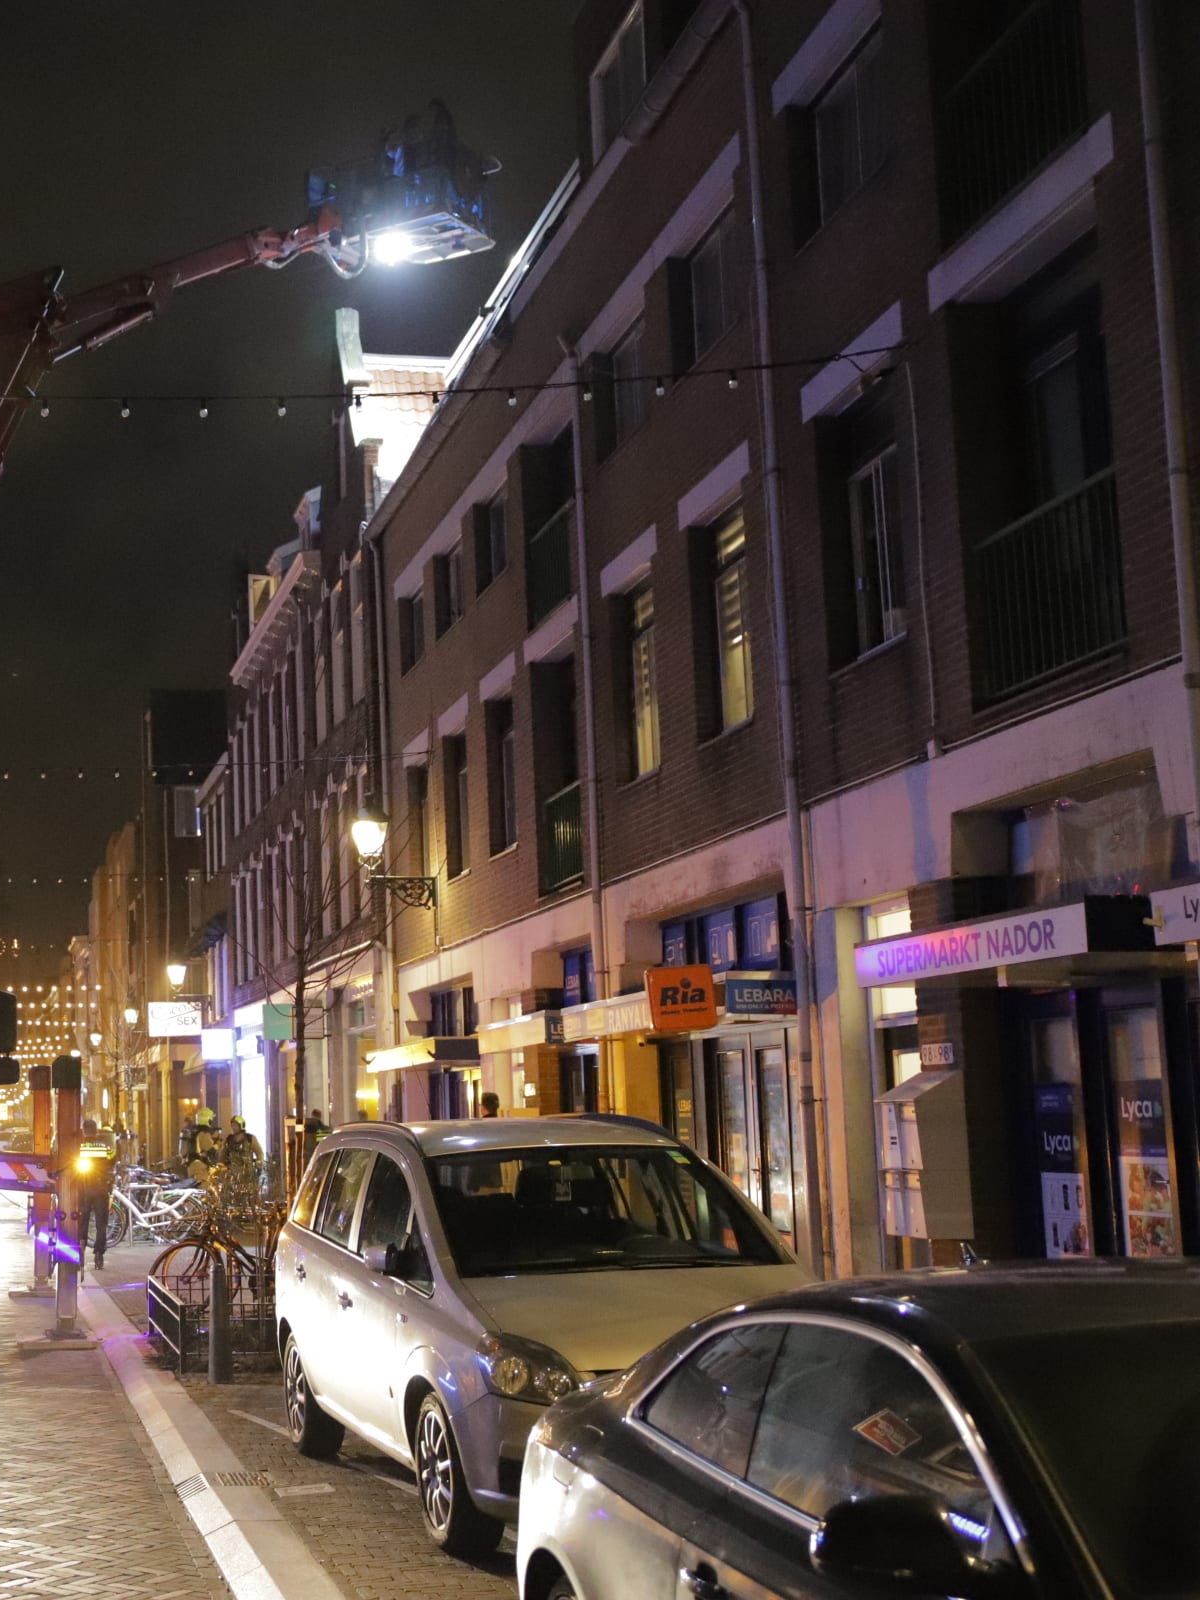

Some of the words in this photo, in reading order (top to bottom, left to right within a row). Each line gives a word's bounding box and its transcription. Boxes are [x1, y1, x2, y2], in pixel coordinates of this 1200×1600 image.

[877, 931, 981, 977] SUPERMARKT
[986, 918, 1056, 960] NADOR
[659, 977, 706, 1007] Ria
[734, 988, 794, 1002] LEBARA
[176, 1016, 198, 1025] SEX
[1120, 1097, 1153, 1122] Lyca
[1043, 1131, 1072, 1155] Lyca
